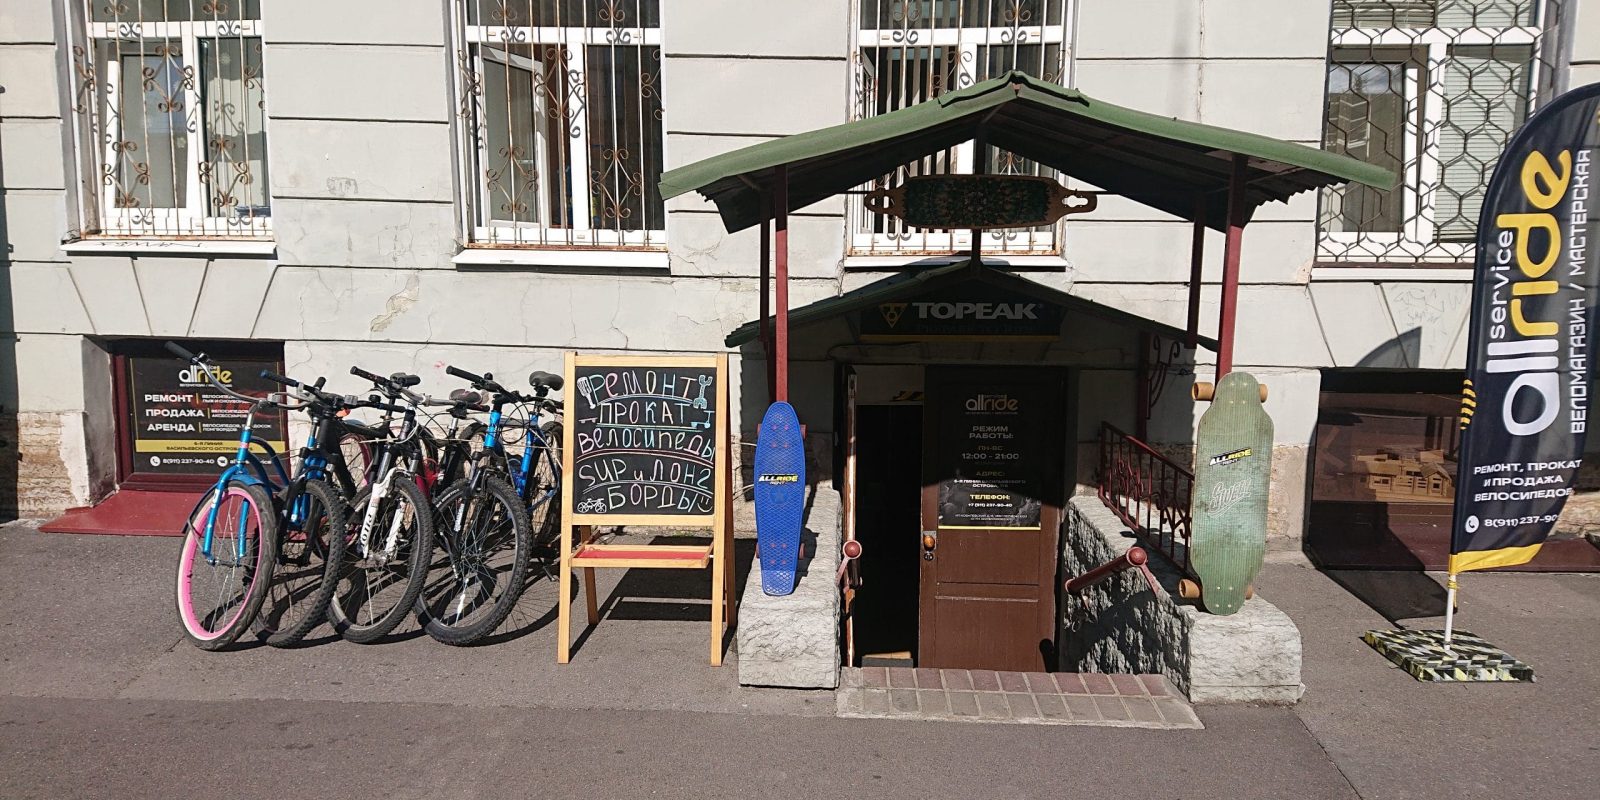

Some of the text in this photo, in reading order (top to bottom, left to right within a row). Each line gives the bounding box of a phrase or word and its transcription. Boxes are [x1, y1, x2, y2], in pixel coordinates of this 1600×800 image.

[1568, 149, 1591, 276] МАСТЕРСКАЯ
[1486, 149, 1572, 436] allride
[1488, 230, 1514, 339] service
[912, 302, 1039, 320] TOPEAK
[1568, 299, 1587, 434] ВЕЛОМАГАЗИН
[144, 394, 194, 403] РЕМОНТ
[965, 394, 1018, 411] allride
[145, 408, 205, 418] ПРОДАЖА
[600, 400, 692, 425] ПРОКАТ
[147, 423, 196, 432] АРЕНДА
[1209, 448, 1252, 465] ALLRIDE
[578, 459, 627, 487] SUP
[1473, 459, 1583, 475] РЕМОНТ, ПРОКАТ
[1491, 474, 1564, 487] ПРОДАЖА
[1484, 518, 1519, 528] 8(911)
